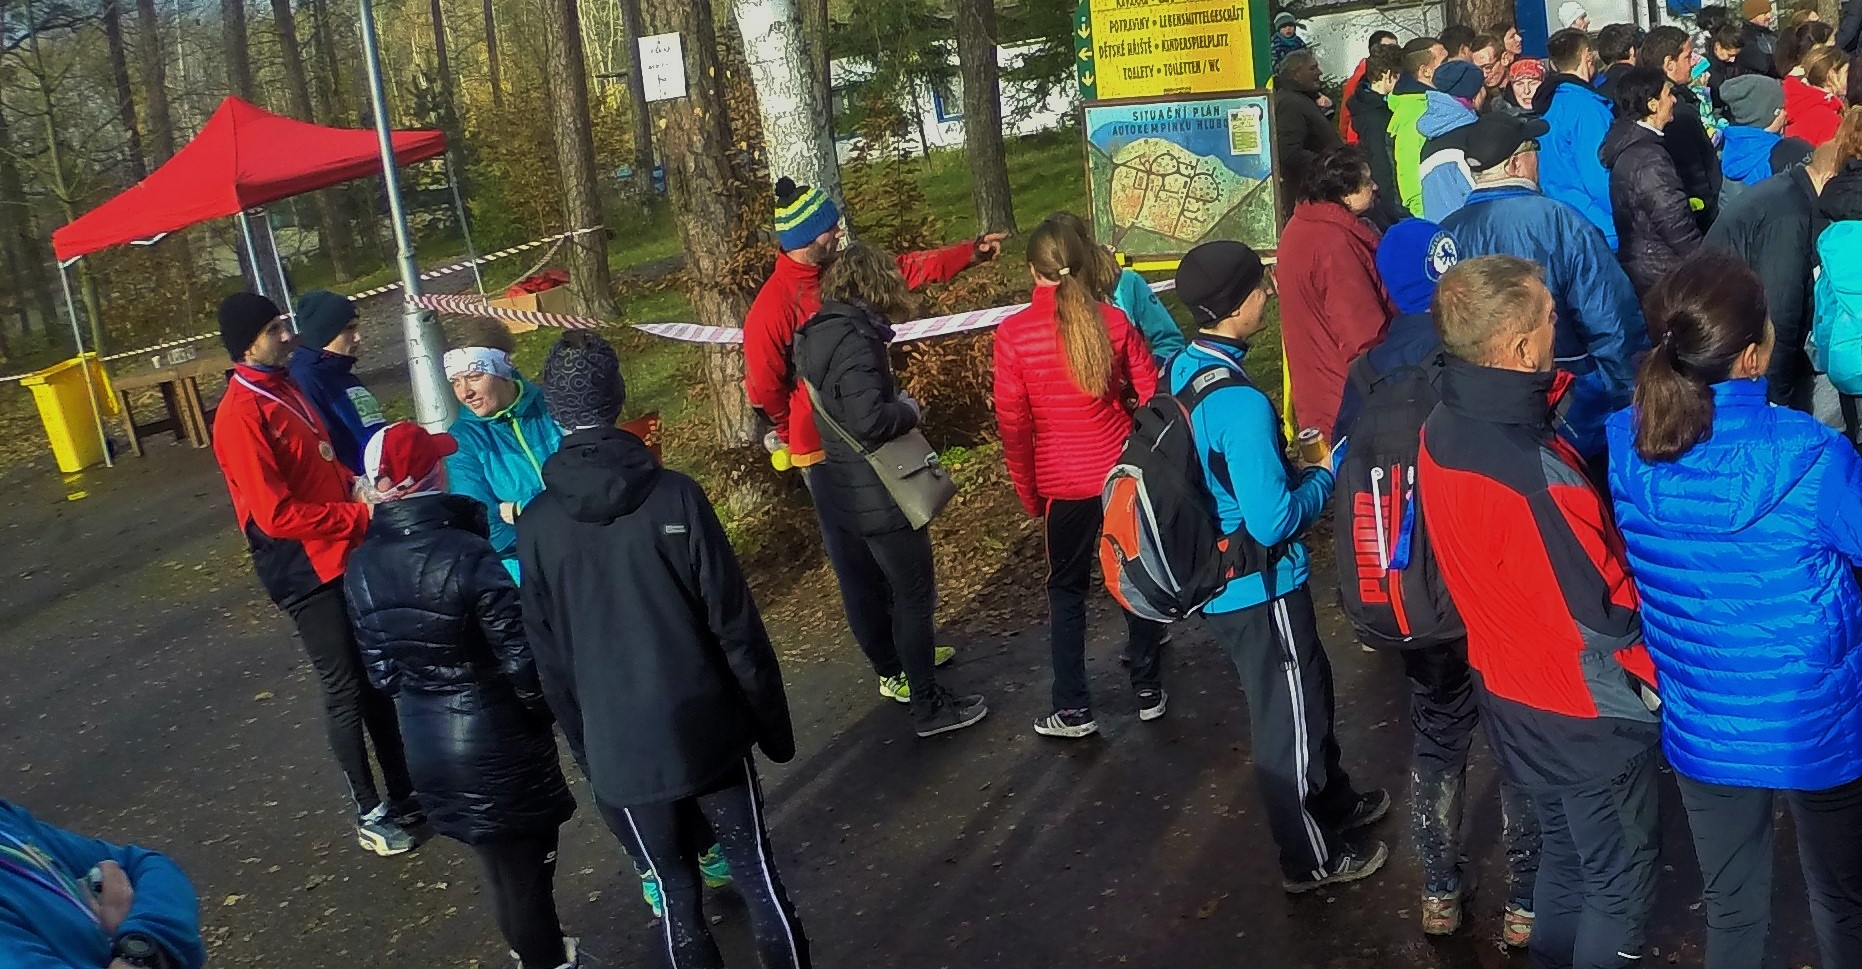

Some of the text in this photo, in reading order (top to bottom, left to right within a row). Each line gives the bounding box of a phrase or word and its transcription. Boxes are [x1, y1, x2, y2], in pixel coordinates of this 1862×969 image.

[1109, 17, 1149, 33] POTRAVINY
[1162, 34, 1229, 52] KINDERSPIELPLATZ
[1123, 65, 1154, 80] TOALETY
[1163, 60, 1201, 76] TOILETTEN
[1208, 59, 1220, 72] WC
[1132, 105, 1220, 121] SITUAČNÍ PLÁN
[1112, 118, 1229, 136] AUTOKEMPINKU HLUBO
[1353, 491, 1391, 603] PUMA
